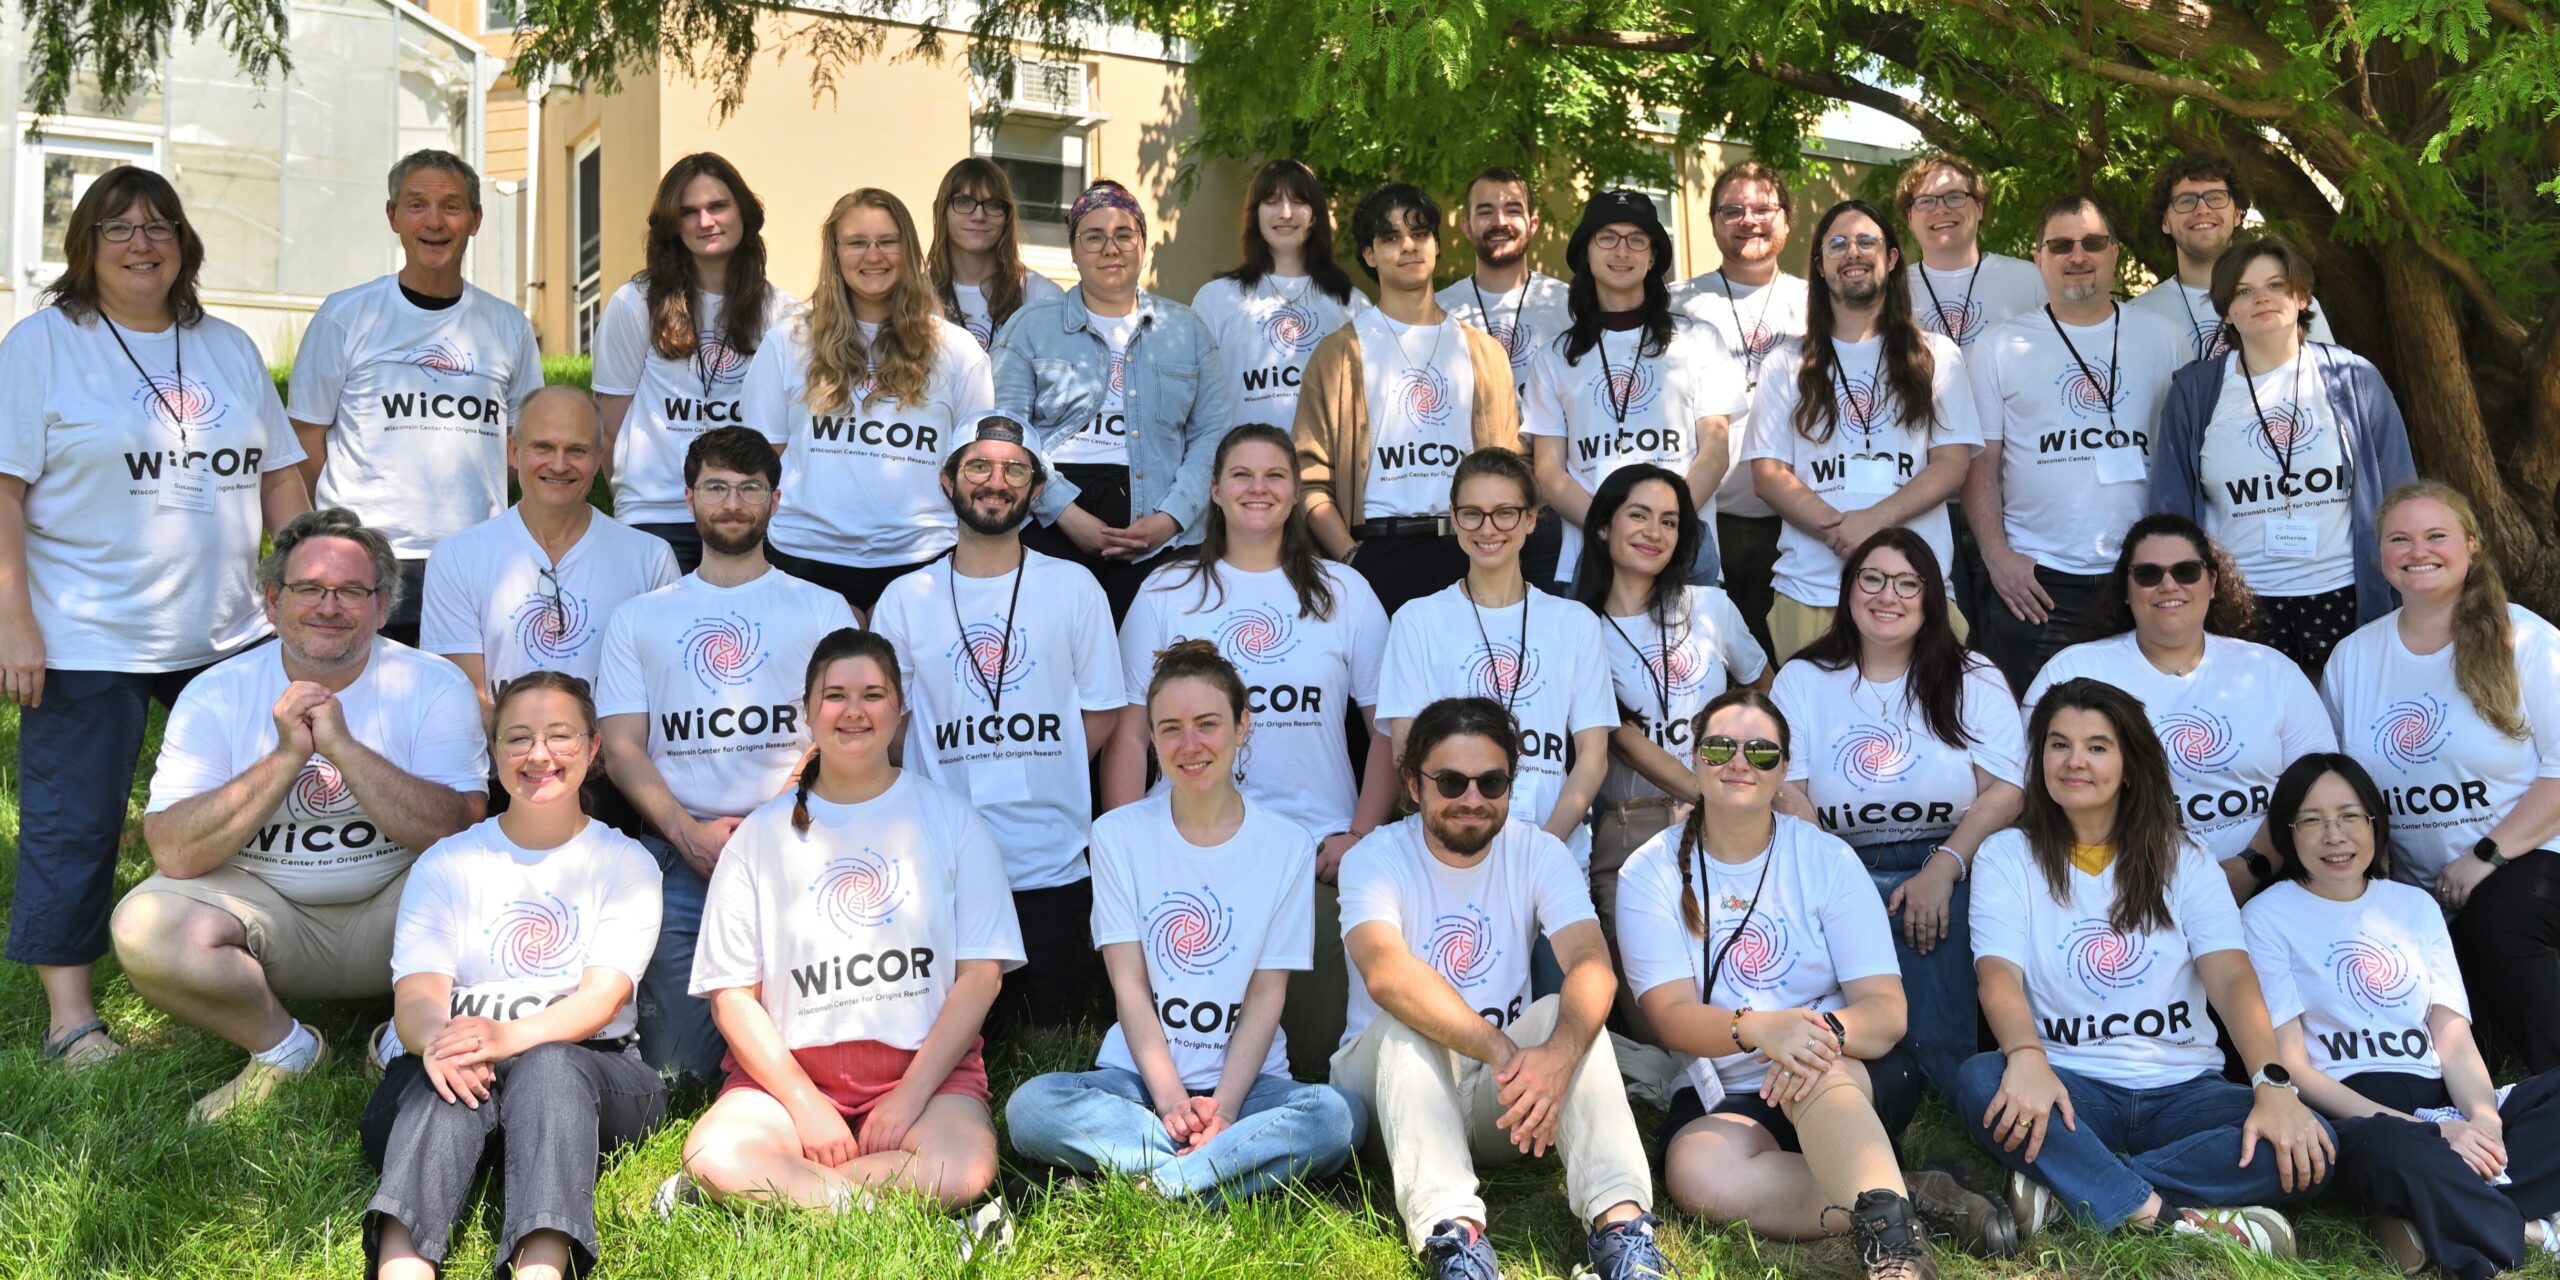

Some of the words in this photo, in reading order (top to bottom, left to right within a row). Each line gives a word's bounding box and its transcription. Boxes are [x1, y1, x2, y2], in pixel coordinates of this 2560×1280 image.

[1243, 366, 1301, 391] WiC
[382, 392, 499, 425] WiCOR
[665, 398, 742, 422] WiCO
[812, 416, 937, 453] WiCOR
[1578, 428, 1680, 462] WiCOR
[844, 448, 868, 457] Center
[882, 452, 905, 462] Origins
[907, 456, 936, 466] Research
[1378, 442, 1464, 470] WiCO
[1811, 452, 1914, 483] WiR
[2037, 457, 2067, 465] Wisconsin
[217, 484, 235, 493] rigins
[2232, 510, 2266, 518] Wisconsin
[1246, 684, 1321, 714] COR
[662, 705, 798, 741] WiCOR
[936, 712, 1061, 750] WiCOR
[667, 748, 697, 756] Wisconsin
[736, 743, 763, 752] Origins
[766, 741, 796, 749] Research
[966, 752, 990, 760] Center
[1006, 750, 1032, 759] Origins
[2174, 785, 2269, 824] iCOR
[246, 820, 390, 853] WiCO
[2432, 821, 2459, 829] Origins
[319, 858, 332, 866] for
[336, 854, 373, 864] Origins
[791, 947, 934, 998] WiCOR
[450, 993, 568, 1021] WiC
[834, 998, 859, 1008] Center
[875, 992, 902, 1001] Origins
[2043, 1000, 2192, 1047] WiCOR
[1184, 1040, 1212, 1050] Origins
[2318, 1028, 2428, 1061] WiCO
